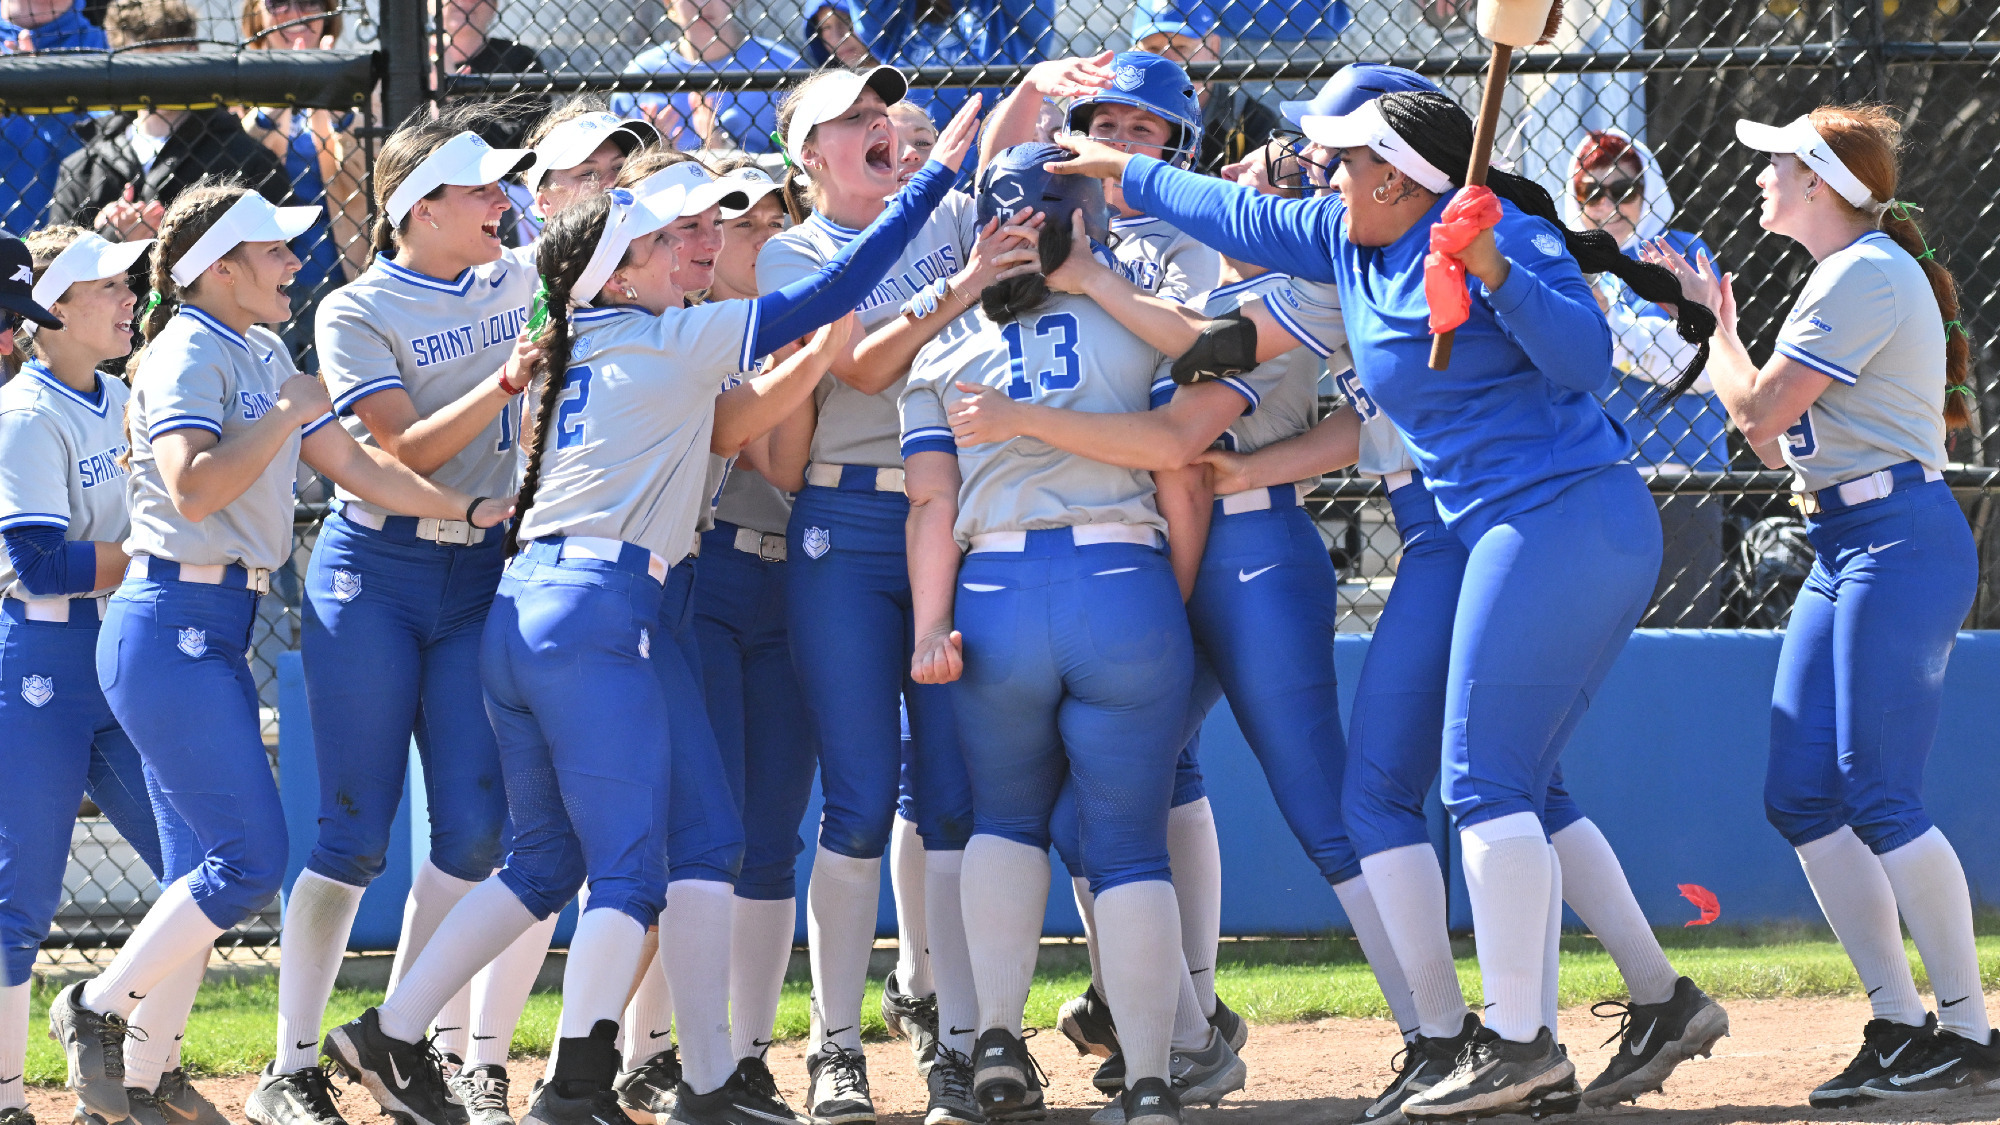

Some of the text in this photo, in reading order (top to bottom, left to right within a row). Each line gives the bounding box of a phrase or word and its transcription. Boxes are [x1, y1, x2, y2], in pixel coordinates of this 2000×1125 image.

[411, 325, 475, 367] SAINT
[1001, 312, 1081, 400] 13
[556, 364, 594, 451] 2
[984, 1046, 1004, 1058] NIKE
[1140, 1095, 1161, 1106] NIKE
